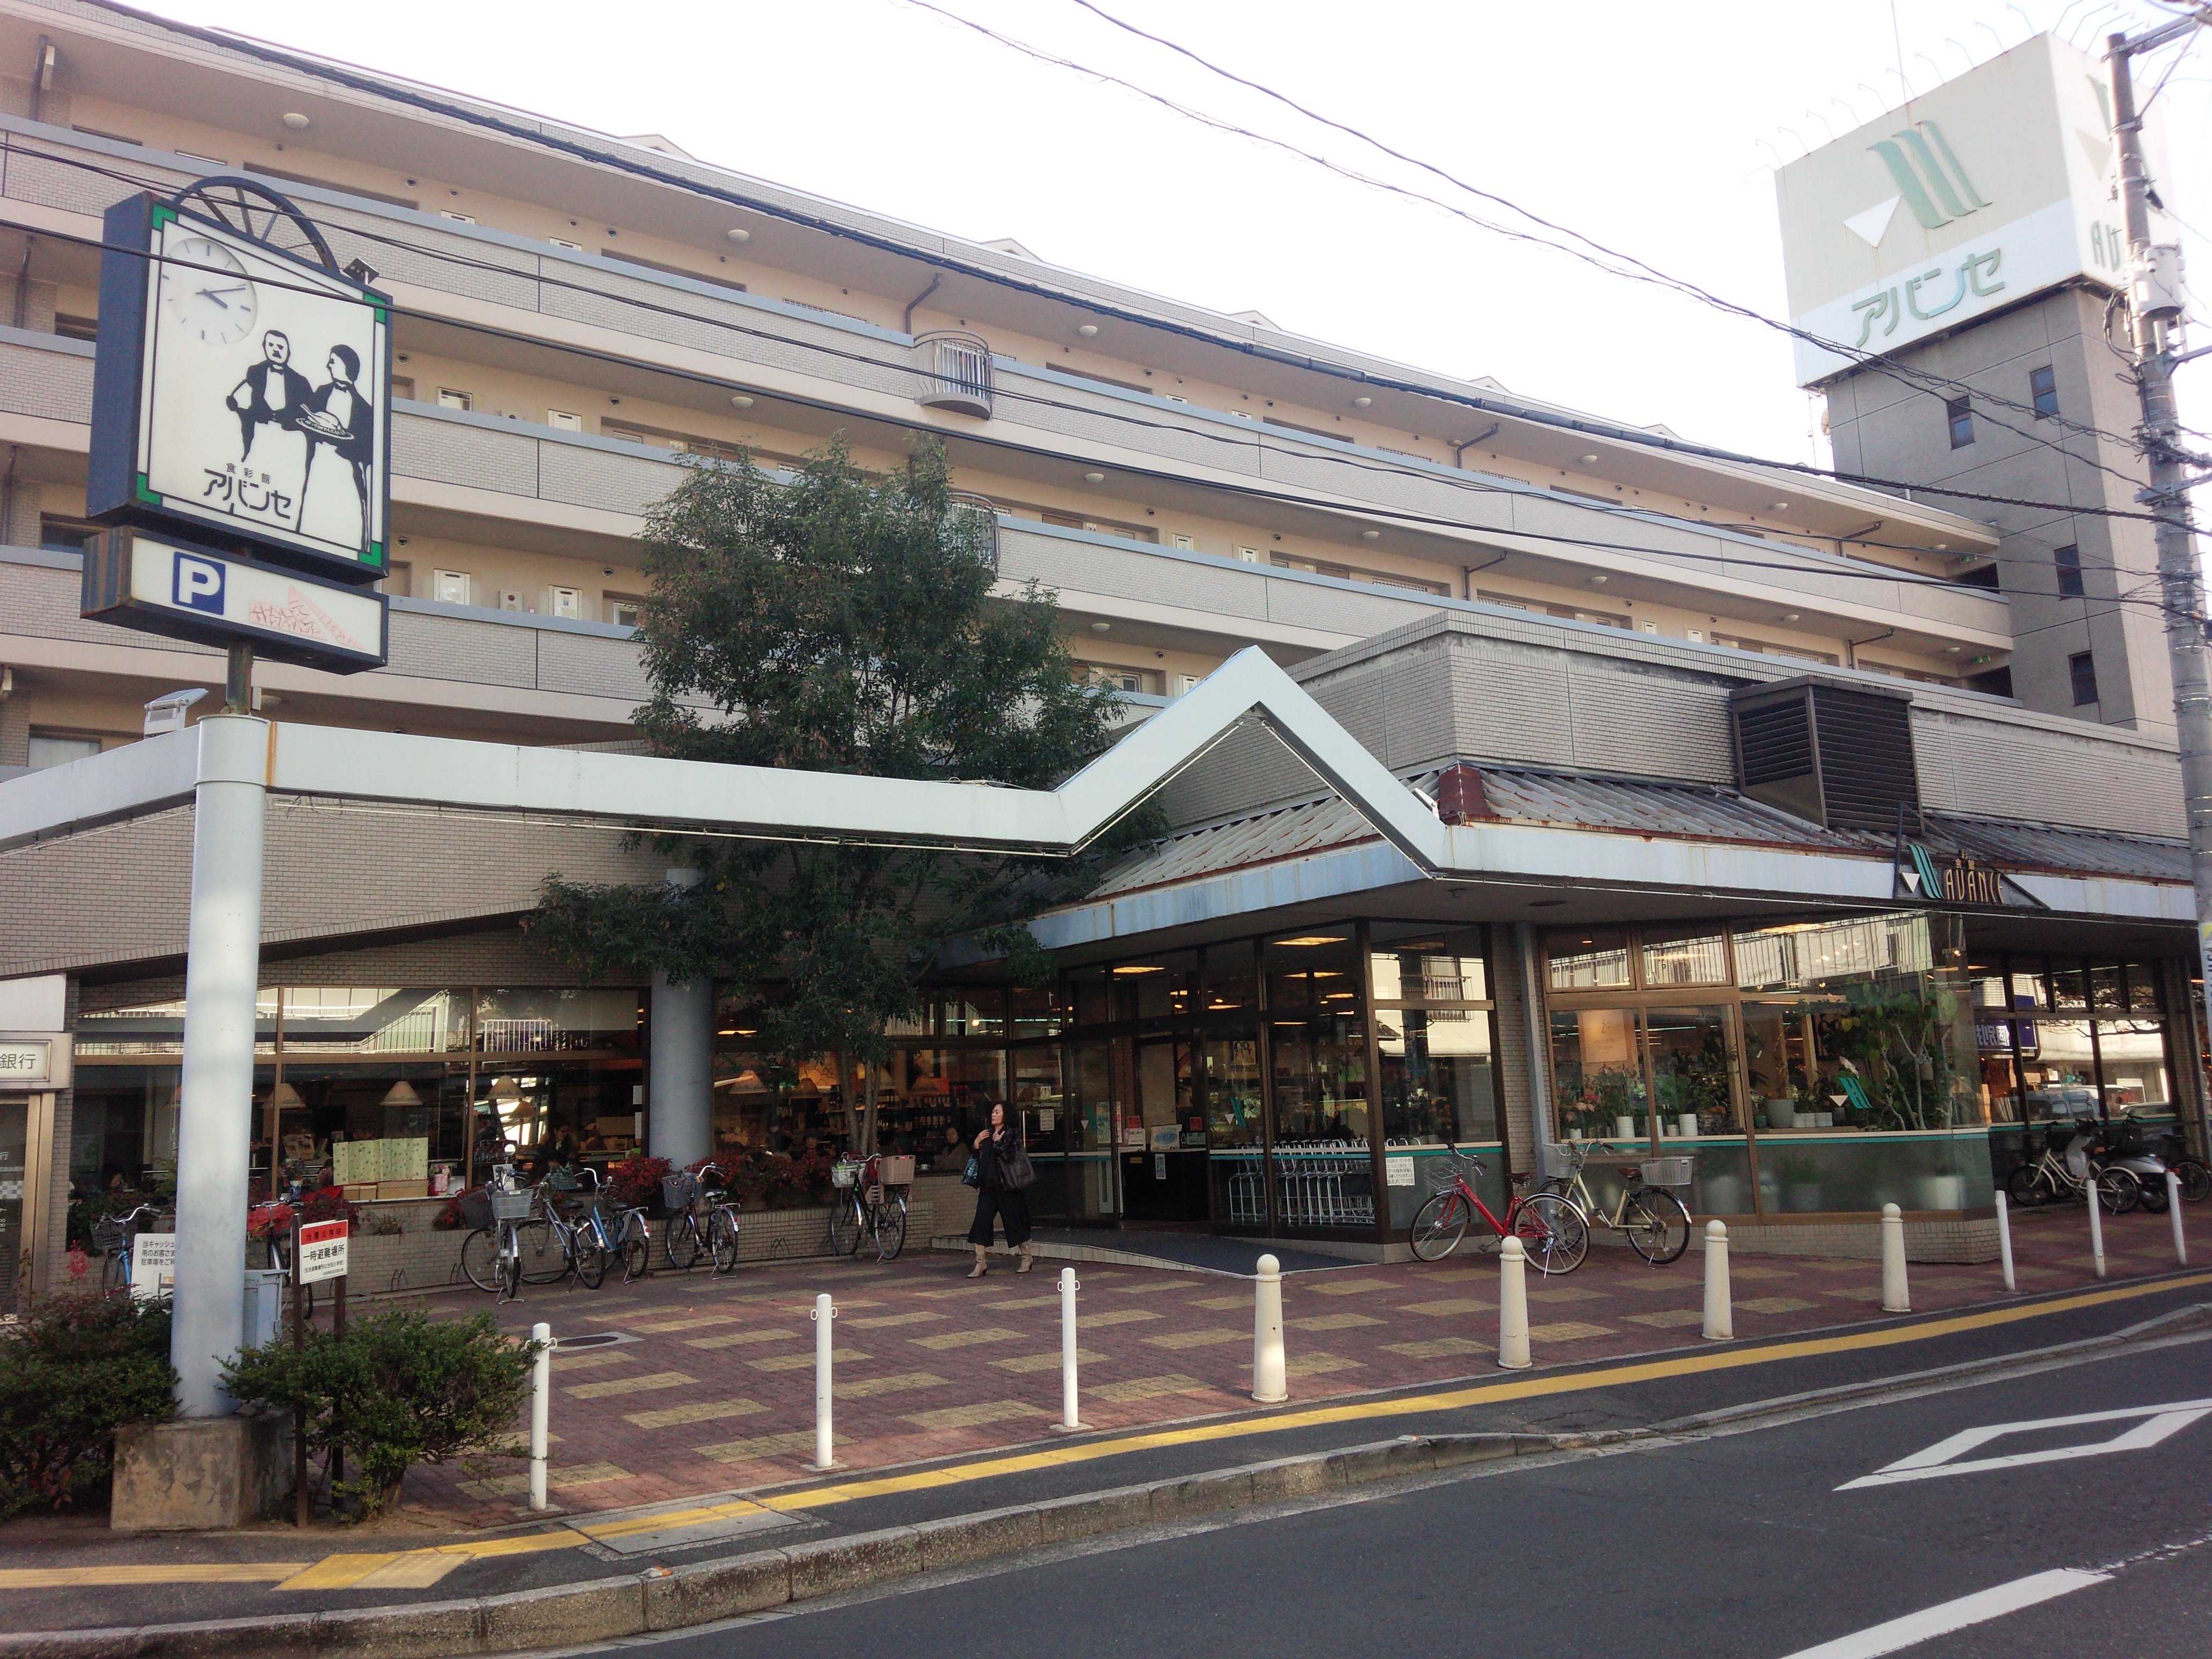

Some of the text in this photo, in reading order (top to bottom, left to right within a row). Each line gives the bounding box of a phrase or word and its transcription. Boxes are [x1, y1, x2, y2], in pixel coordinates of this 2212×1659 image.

[1851, 248, 2005, 348] アバンセ
[203, 468, 292, 520] アバンセ
[226, 462, 271, 484] 食彩館
[178, 558, 221, 604] P
[303, 1244, 345, 1261] 一時避難場所
